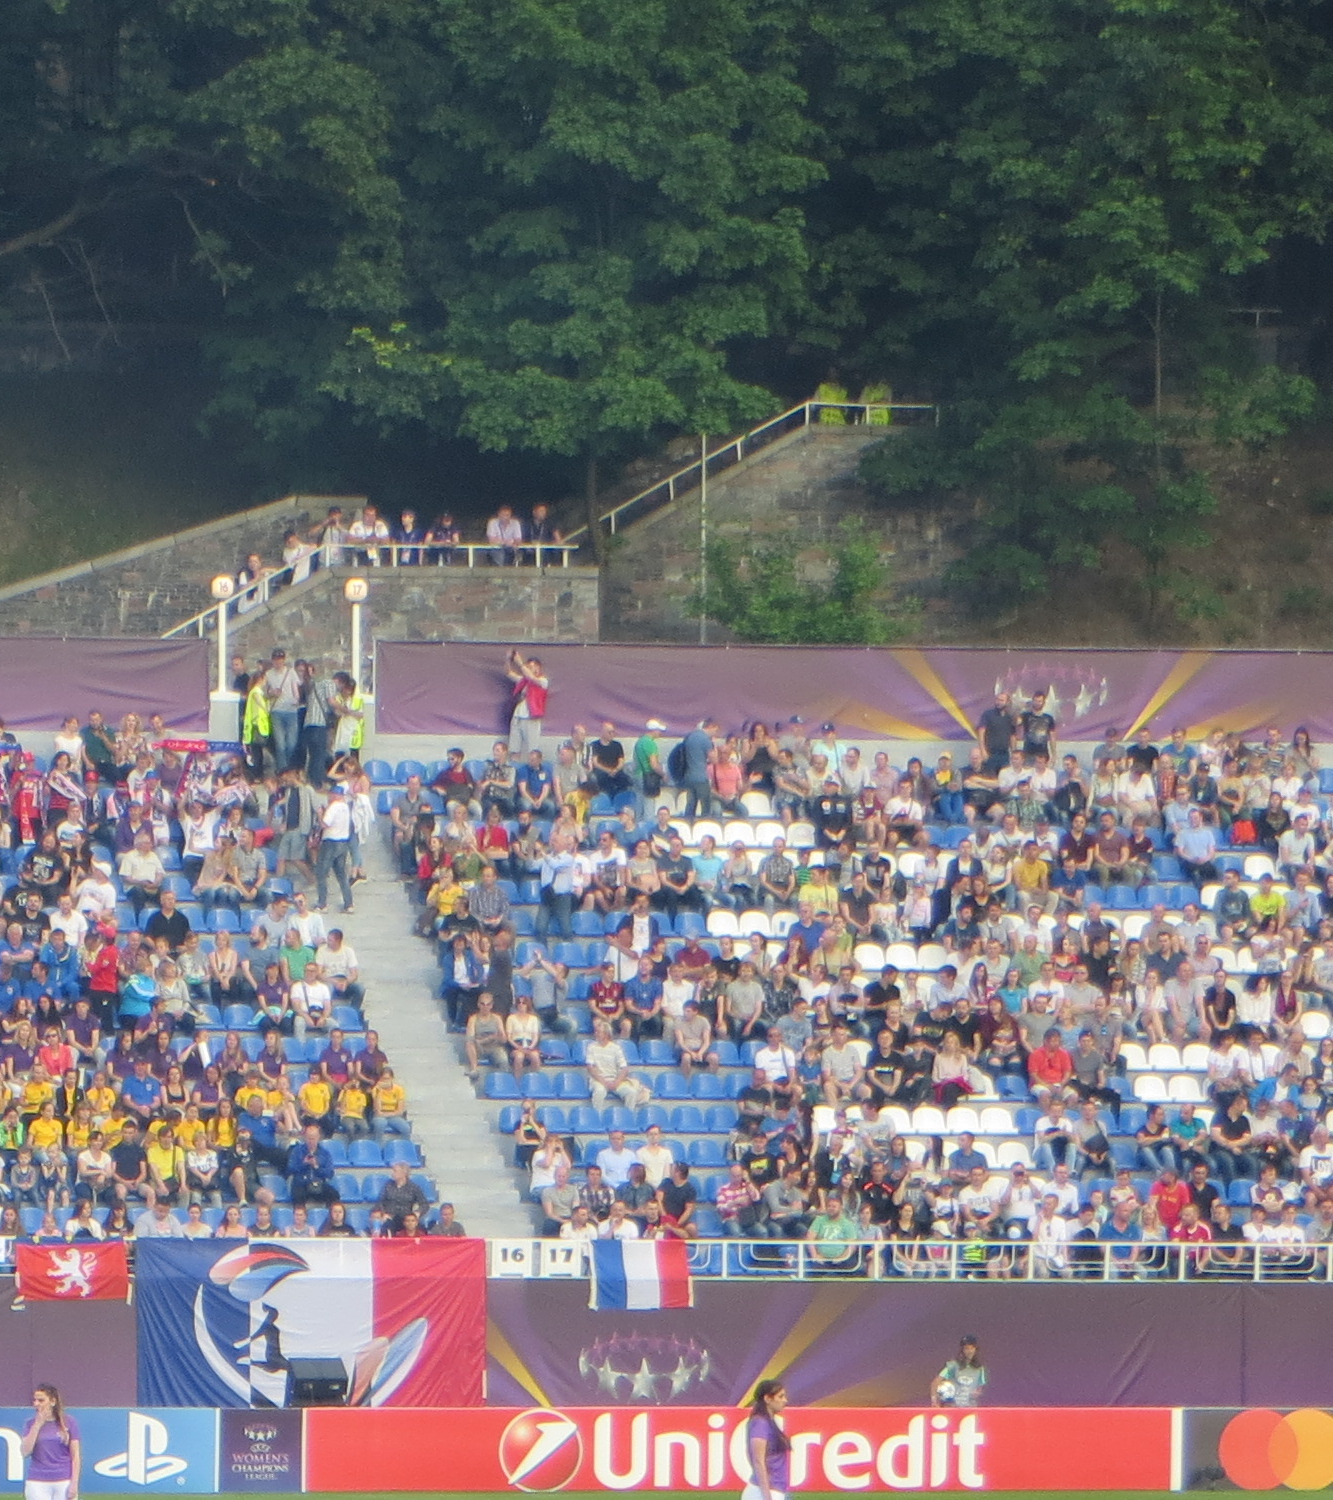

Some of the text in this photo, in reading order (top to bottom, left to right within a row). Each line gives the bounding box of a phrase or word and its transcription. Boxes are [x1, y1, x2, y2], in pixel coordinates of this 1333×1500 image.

[500, 1247, 524, 1263] 16
[549, 1248, 573, 1263] 17
[232, 1453, 290, 1463] WOMEN'S
[231, 1463, 290, 1474] CHAMPIONS
